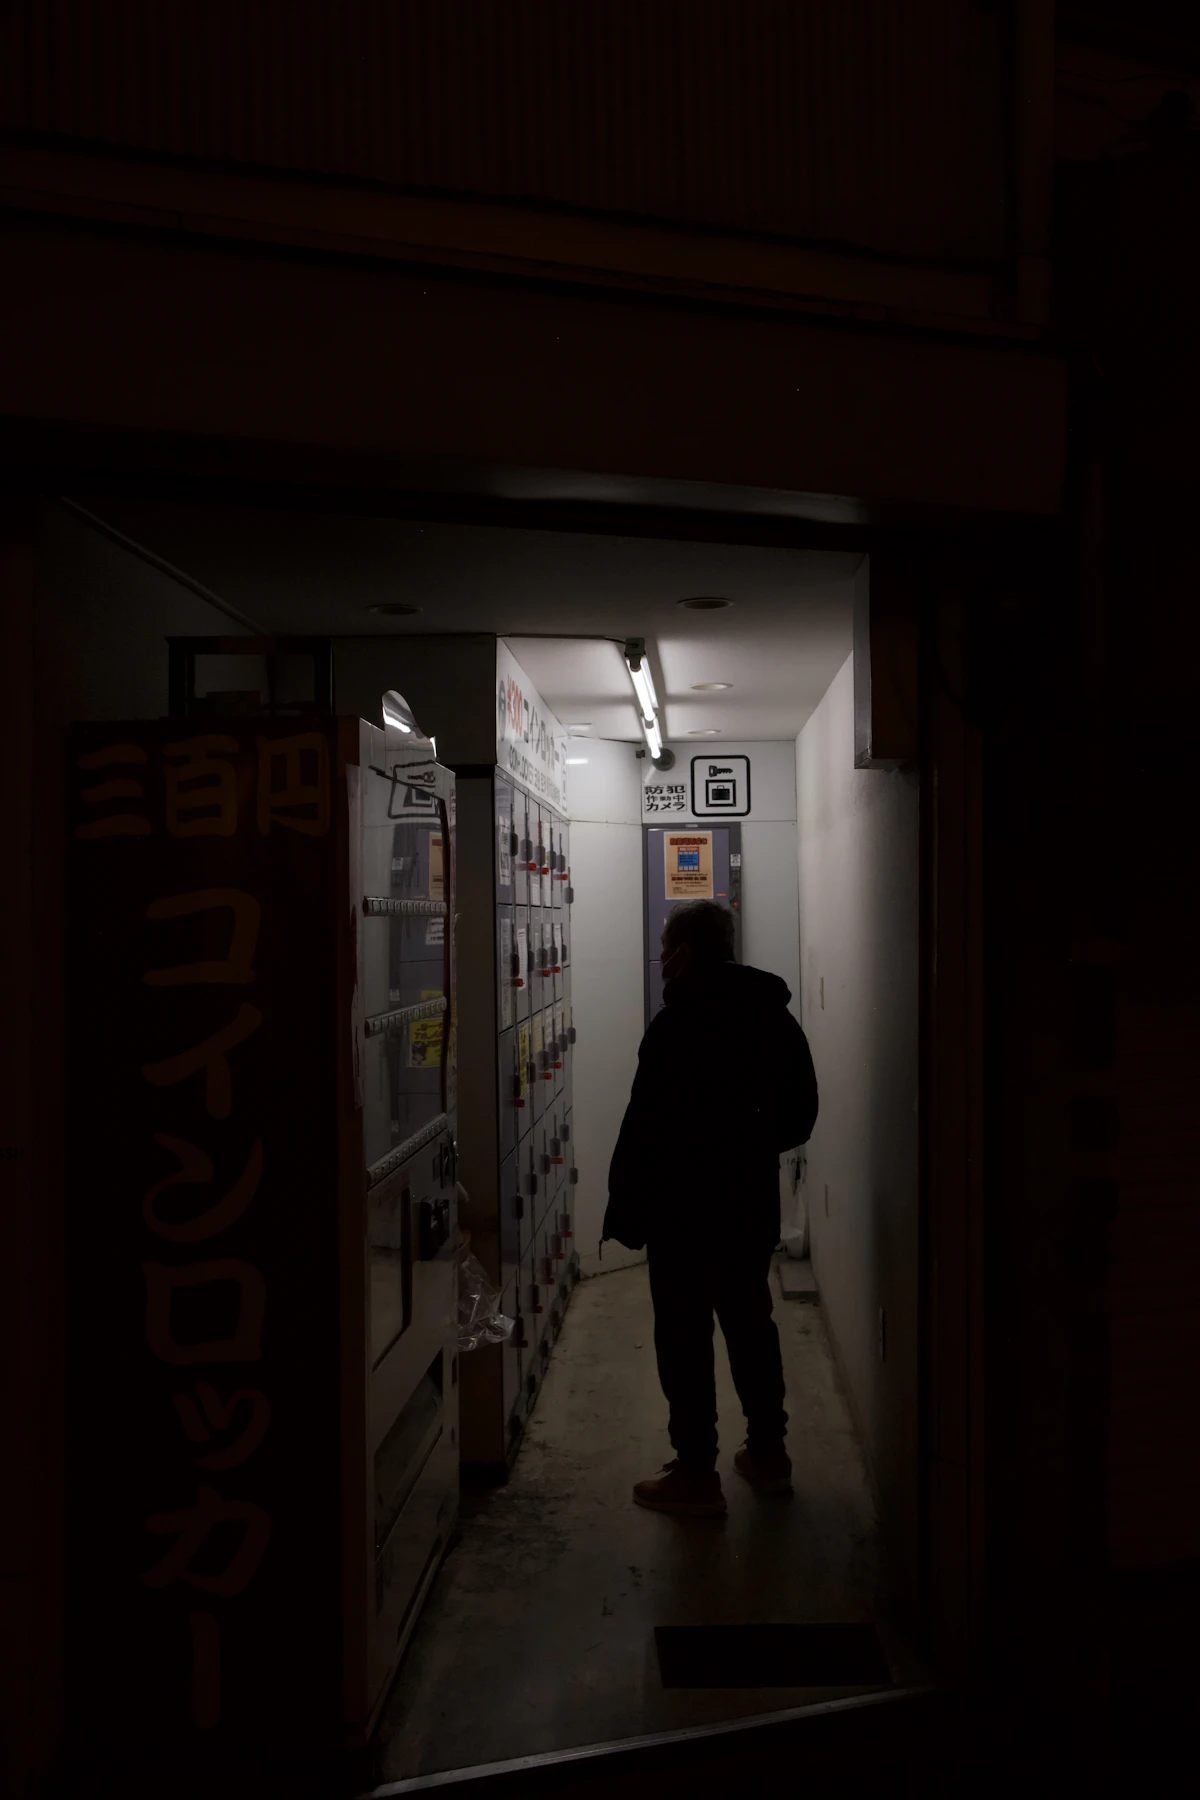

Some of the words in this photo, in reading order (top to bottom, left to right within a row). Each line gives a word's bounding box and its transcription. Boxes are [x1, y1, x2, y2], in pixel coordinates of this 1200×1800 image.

[74, 731, 331, 839] 三百円
[645, 785, 686, 795] 防犯
[646, 802, 686, 812] カメラ
[139, 887, 273, 1730] コインロッカー
